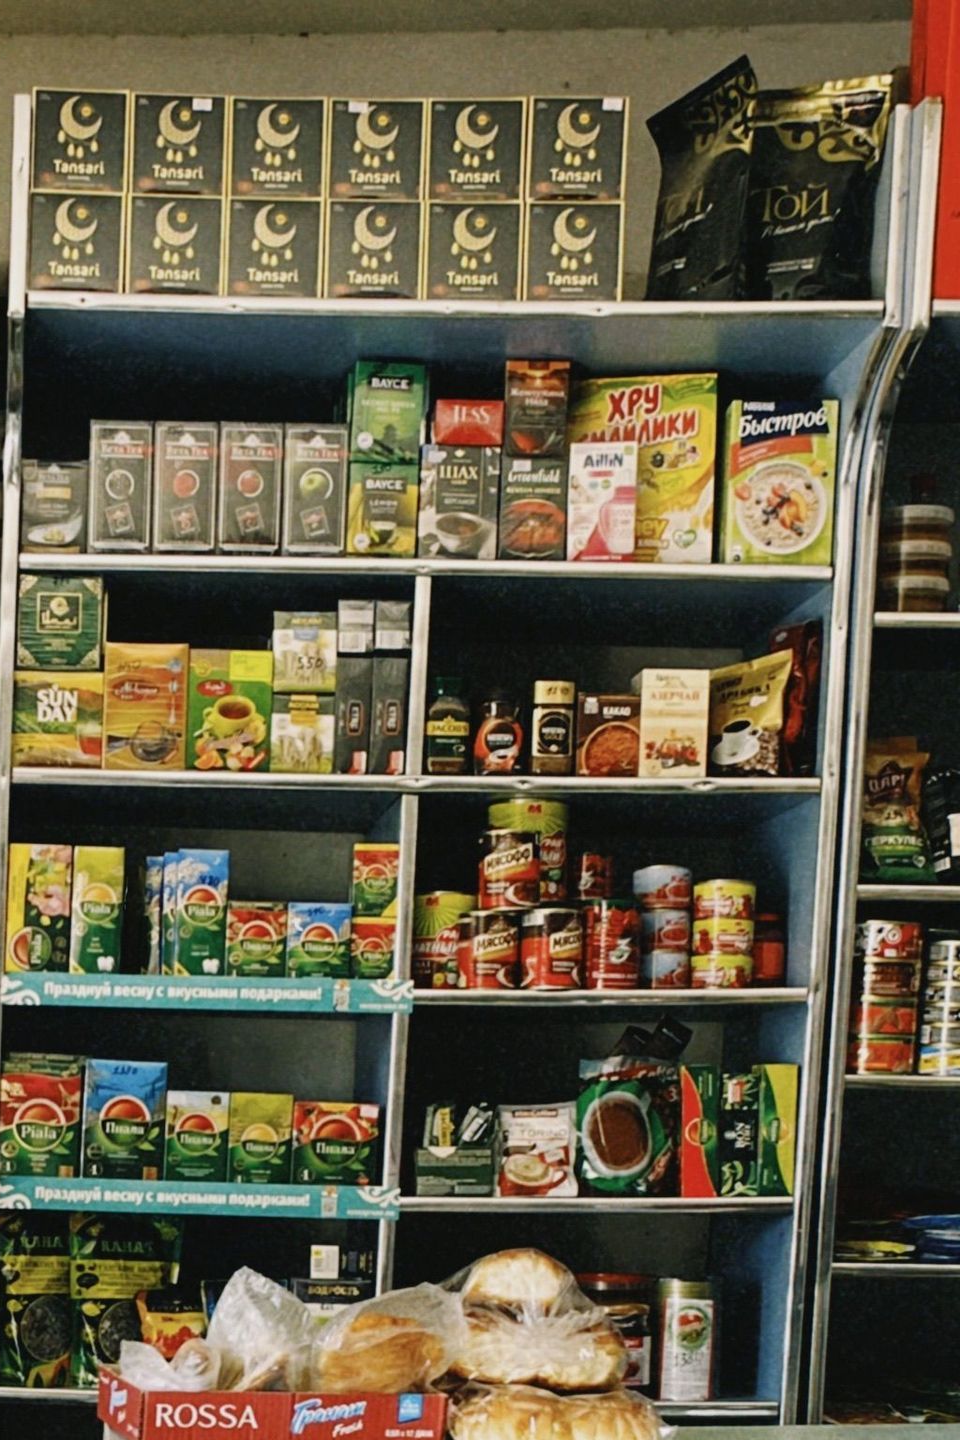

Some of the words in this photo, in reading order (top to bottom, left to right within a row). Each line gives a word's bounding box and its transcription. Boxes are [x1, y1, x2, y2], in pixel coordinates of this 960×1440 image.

[53, 159, 105, 175] Tansari
[152, 164, 204, 180] Tansari
[251, 167, 303, 183] Tansari
[550, 167, 602, 183] Tansari
[349, 169, 401, 185] Tansari
[449, 169, 501, 184] Tansari
[48, 261, 100, 277] Tansari
[148, 265, 200, 282] Tansari
[247, 268, 299, 283] Tansari
[347, 269, 399, 285] Tansari
[446, 270, 498, 286] Tansari
[546, 271, 599, 286] Tansari
[371, 378, 410, 389] BAYCE
[607, 383, 661, 423] ХРУ
[366, 479, 404, 490] BAYCE
[37, 705, 79, 723] DAY
[83, 904, 111, 914] Piala
[187, 905, 216, 917] Piala
[44, 981, 111, 998] Празднуй
[113, 985, 155, 999] весну
[167, 986, 238, 1001] вкусными
[240, 987, 322, 1002] подарками!
[20, 1124, 60, 1140] Piala
[104, 1121, 146, 1137] Пиала
[180, 1132, 214, 1146] Пиала
[245, 1141, 276, 1153] Пиала
[315, 1142, 356, 1156] Пиала
[34, 1186, 101, 1202] Празднуй
[103, 1189, 144, 1204] весну
[156, 1193, 227, 1207] вкусными
[229, 1193, 310, 1208] подарками!
[155, 1404, 259, 1430] ROSSA
